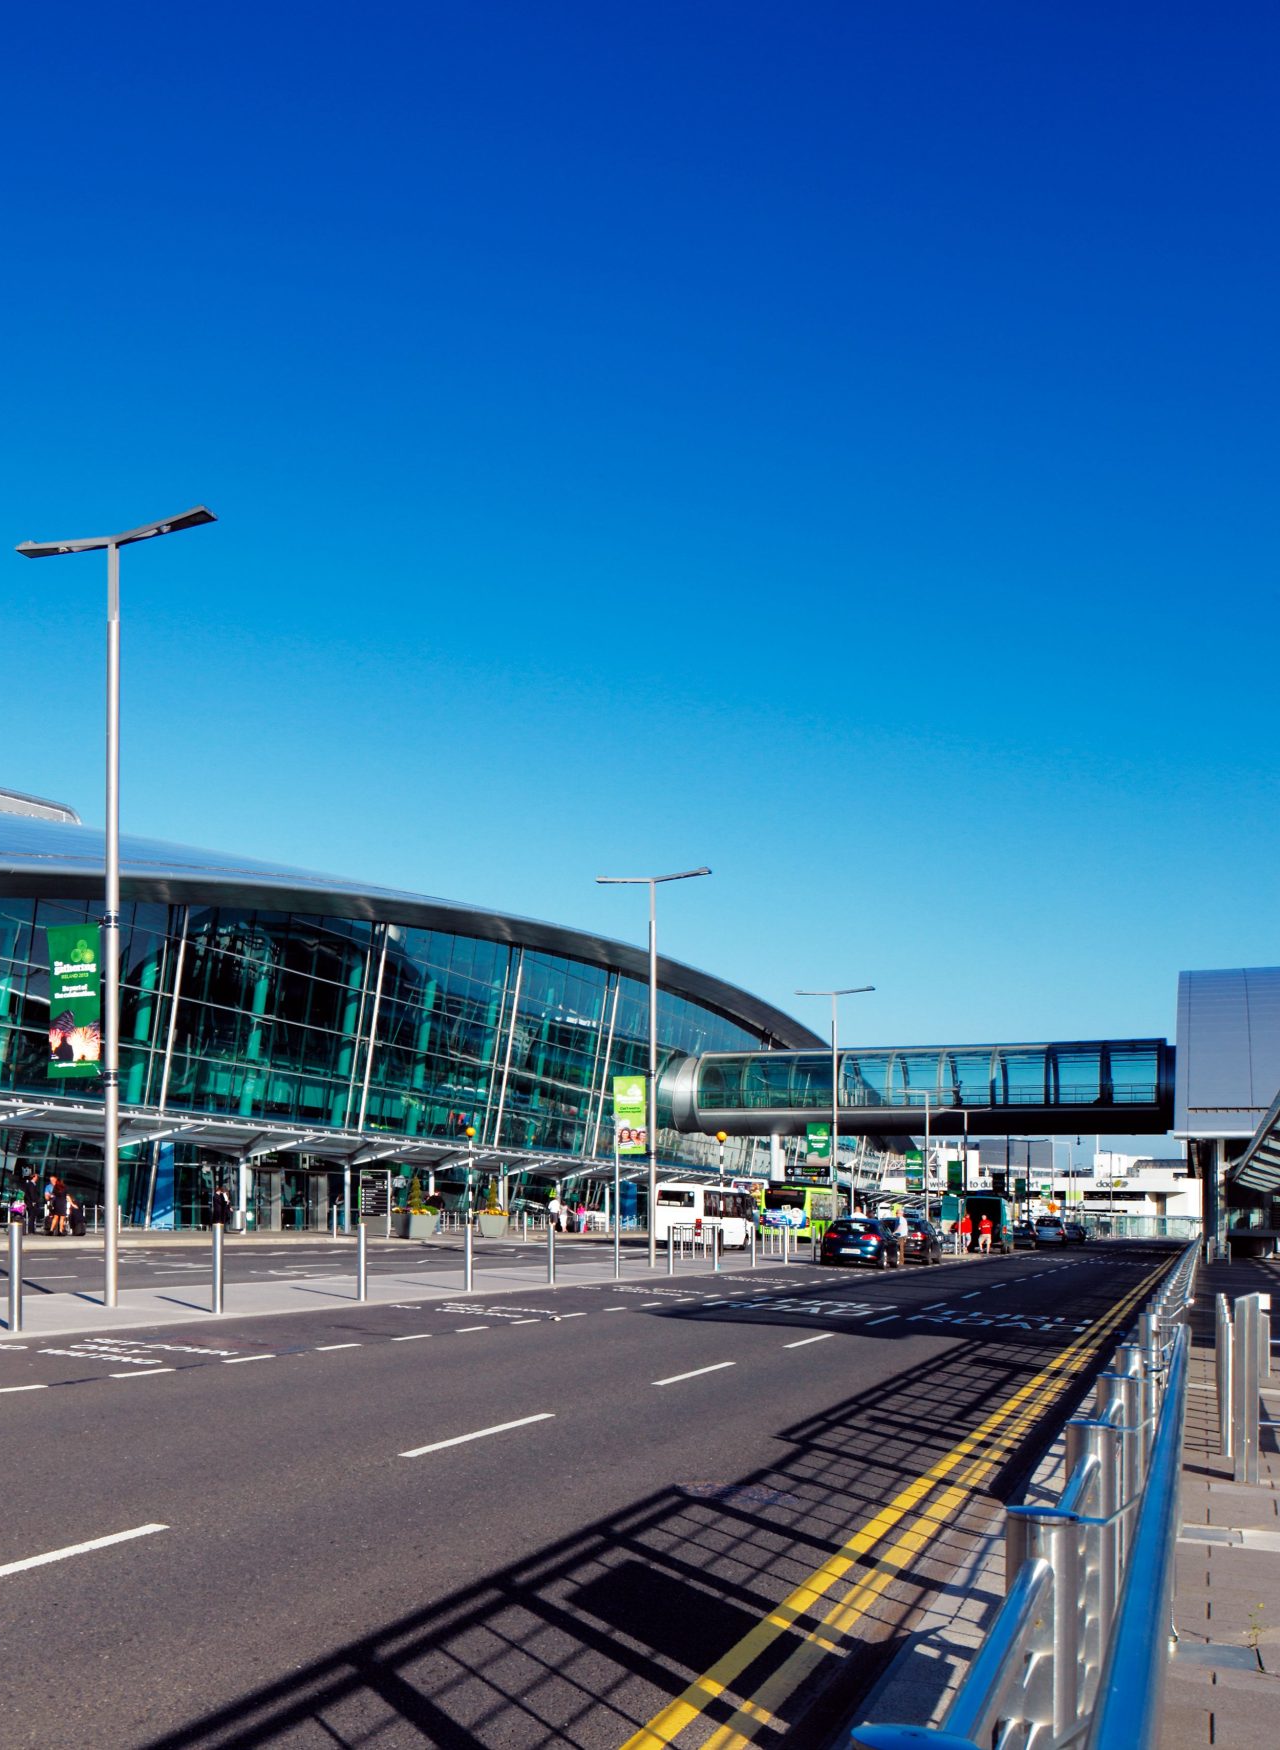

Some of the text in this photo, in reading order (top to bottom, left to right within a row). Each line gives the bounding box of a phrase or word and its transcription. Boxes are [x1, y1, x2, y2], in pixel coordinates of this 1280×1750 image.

[703, 1300, 875, 1317] ROAD
[751, 1296, 898, 1311] THRU
[907, 1315, 1089, 1333] ROAD
[938, 1310, 1094, 1325] THRU
[142, 1343, 239, 1357] DOWN
